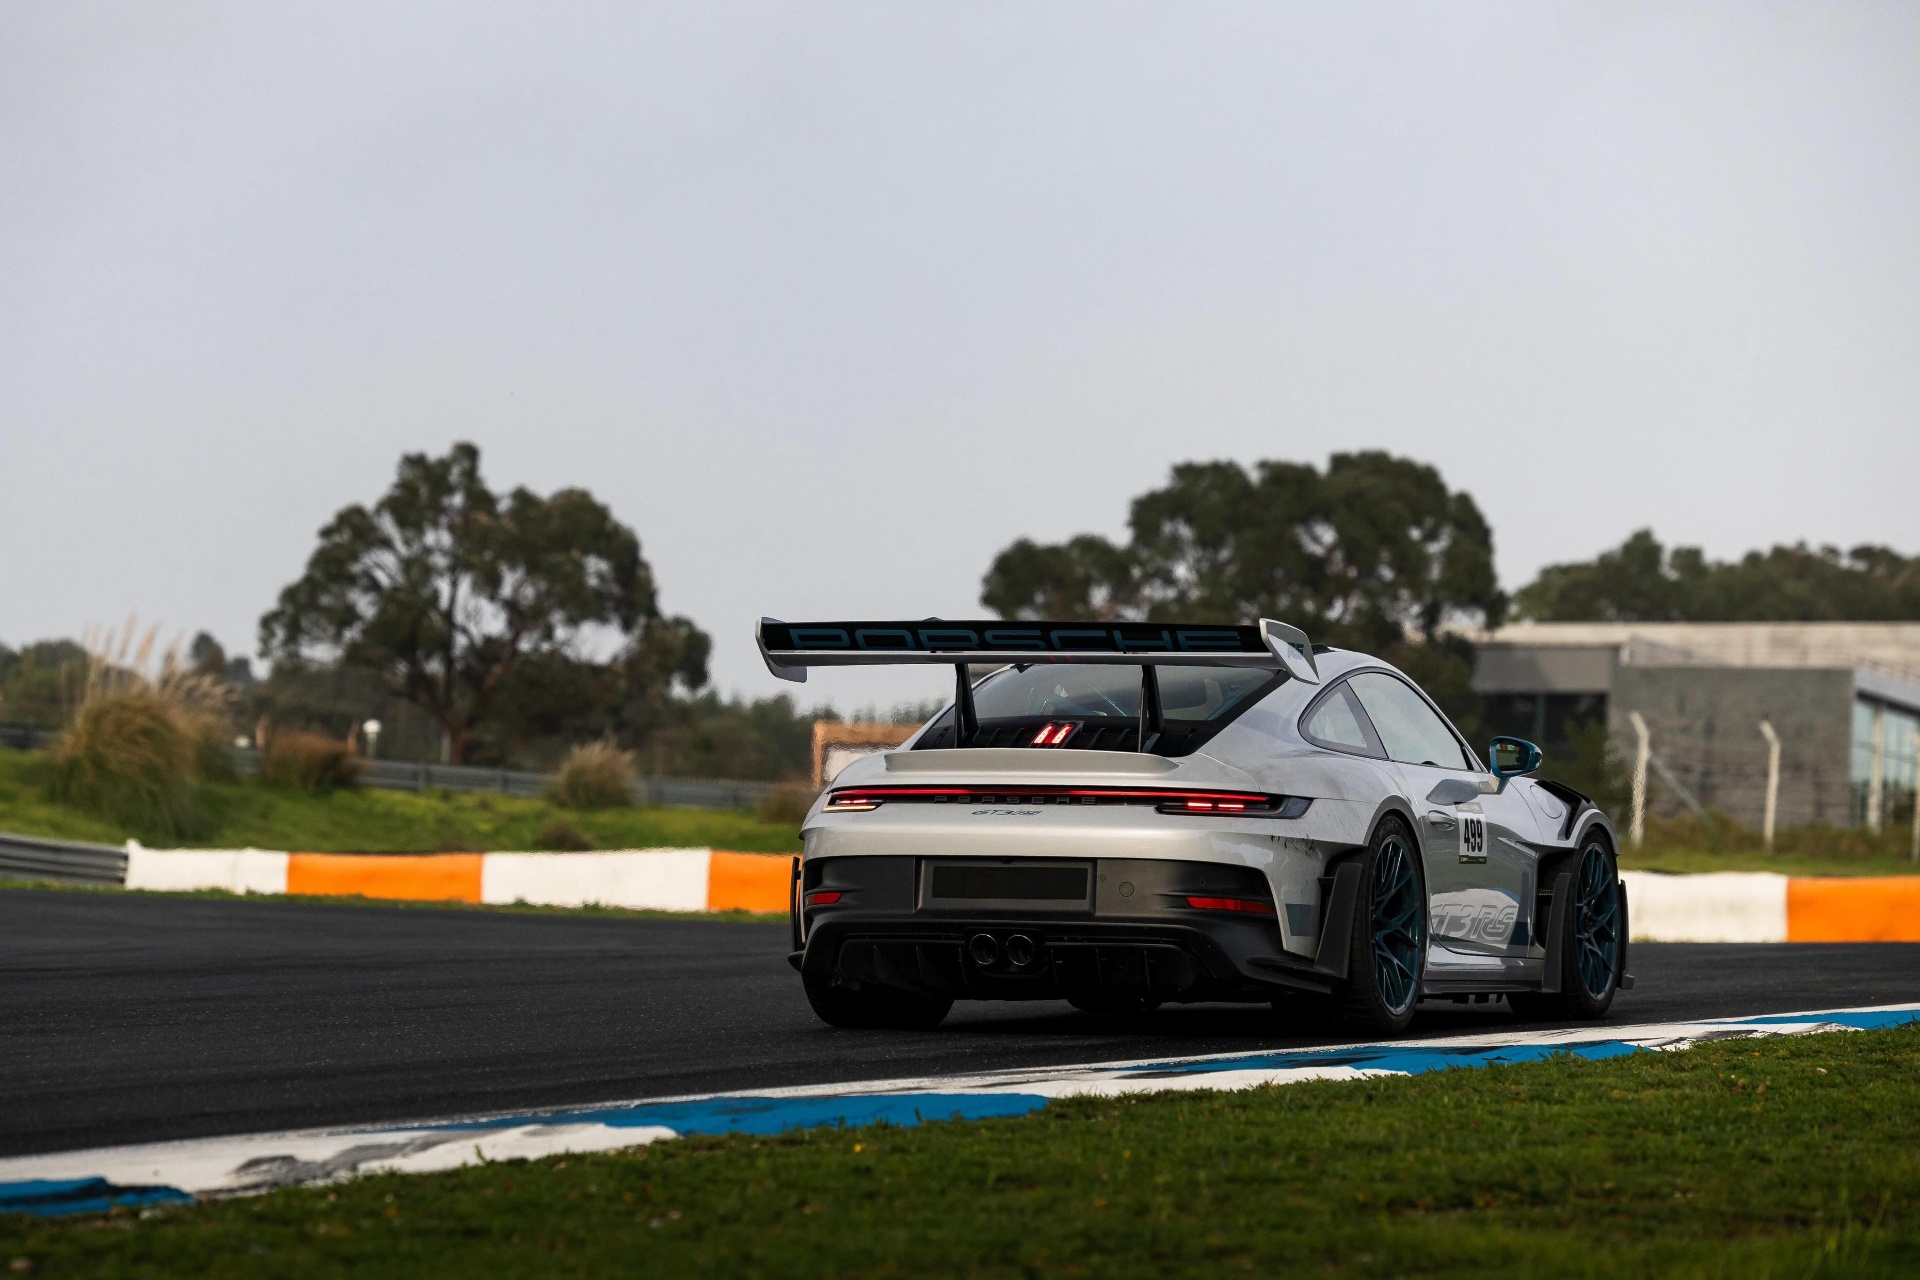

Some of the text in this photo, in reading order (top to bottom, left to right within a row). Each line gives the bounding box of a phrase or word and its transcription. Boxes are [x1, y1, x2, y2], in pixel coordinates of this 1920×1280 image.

[788, 627, 1243, 651] PORSCHE
[933, 796, 1097, 805] PORSCHE
[1463, 817, 1483, 853] 499
